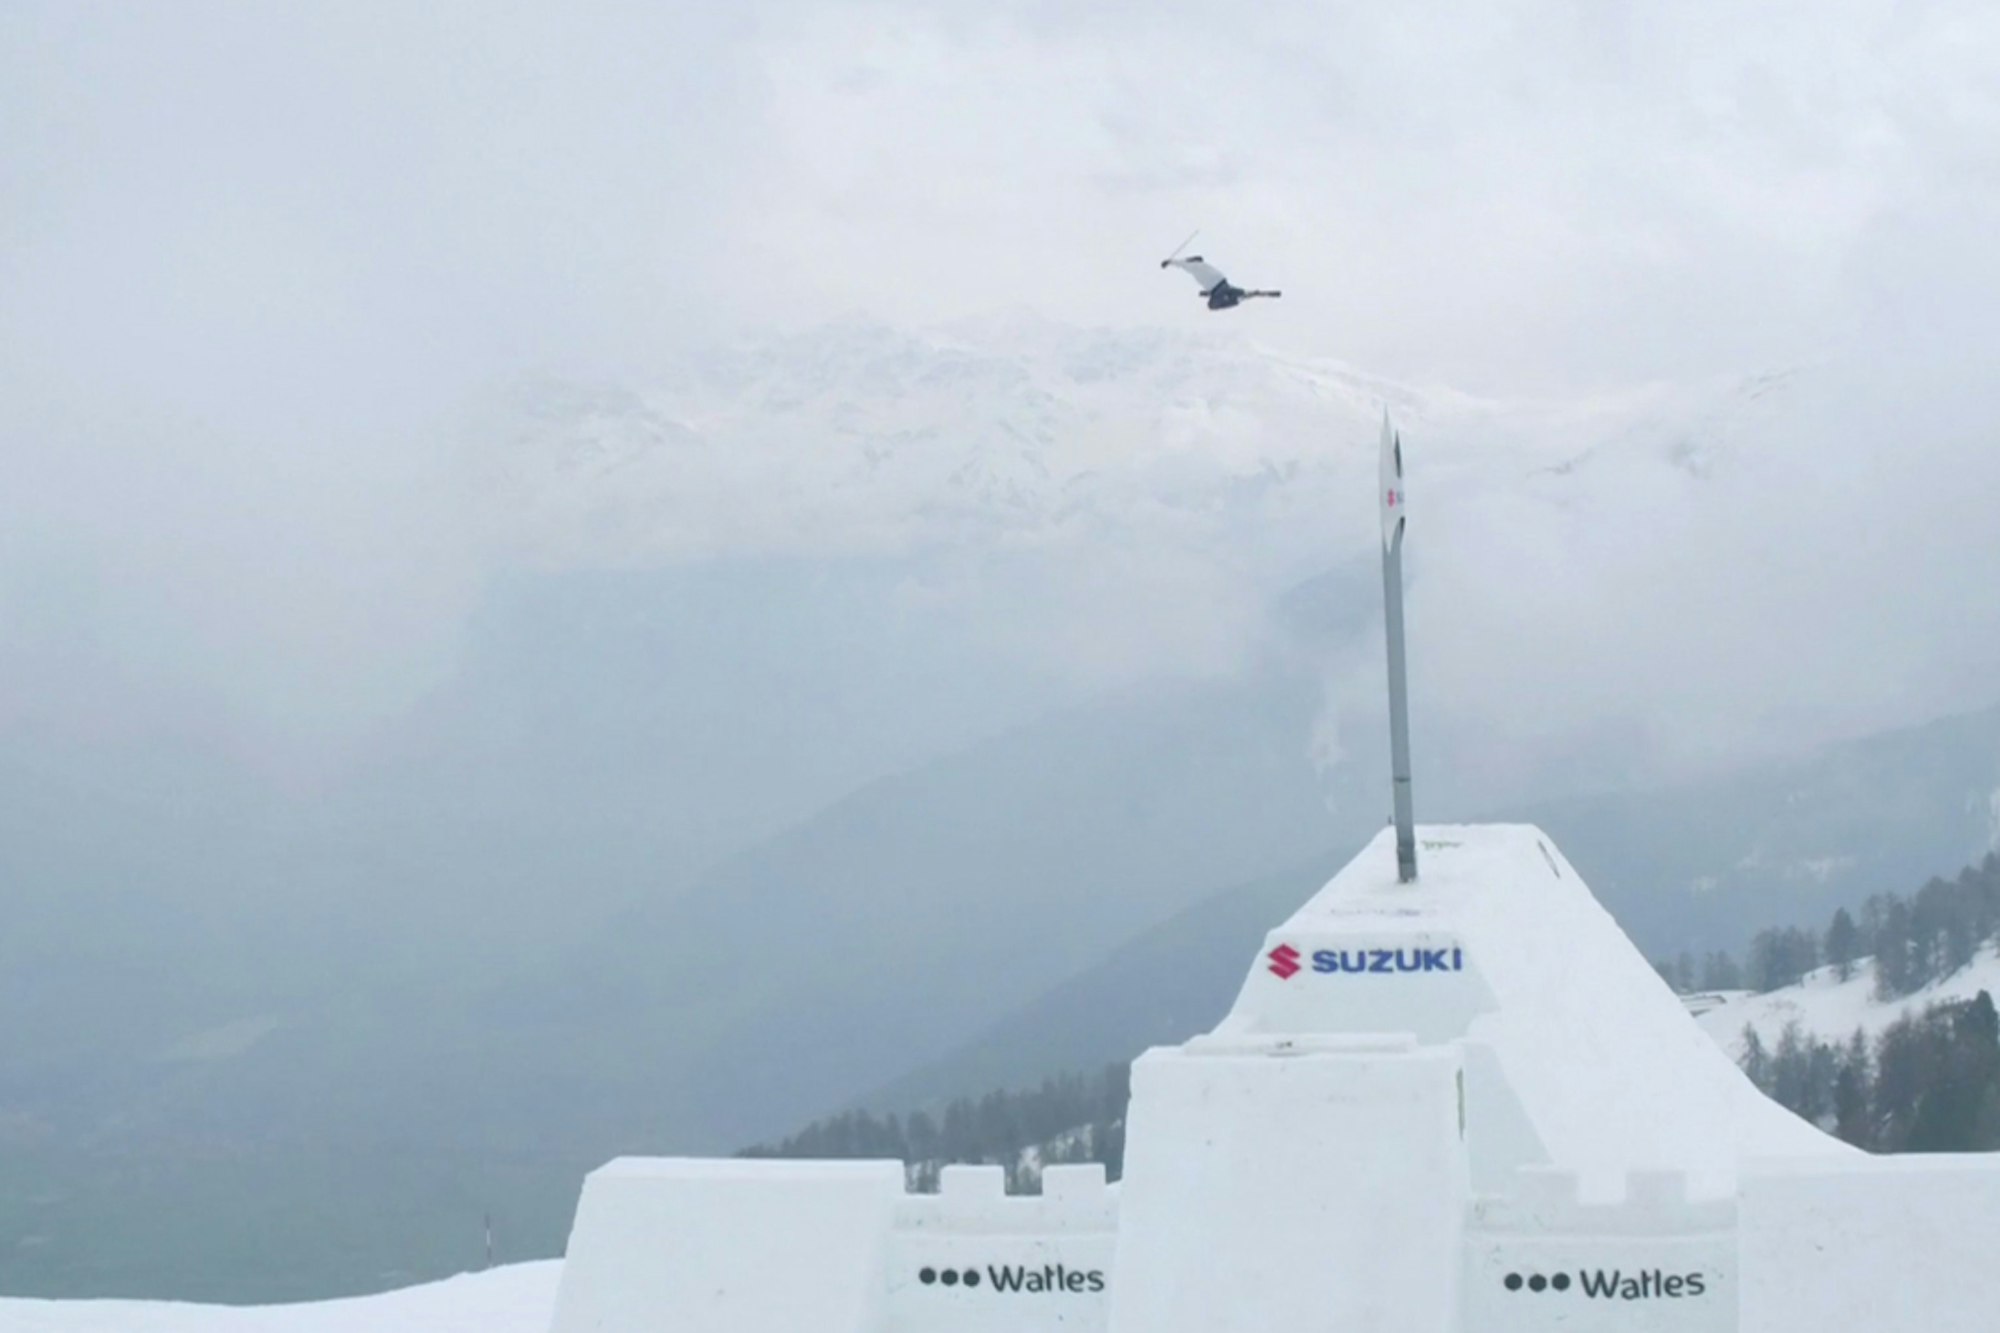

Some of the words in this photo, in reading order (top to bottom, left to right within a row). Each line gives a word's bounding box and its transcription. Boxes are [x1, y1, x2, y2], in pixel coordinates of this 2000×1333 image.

[1311, 947, 1463, 974] SUZUKI
[987, 1263, 1105, 1293] Watles
[1579, 1268, 1706, 1301] Watles
